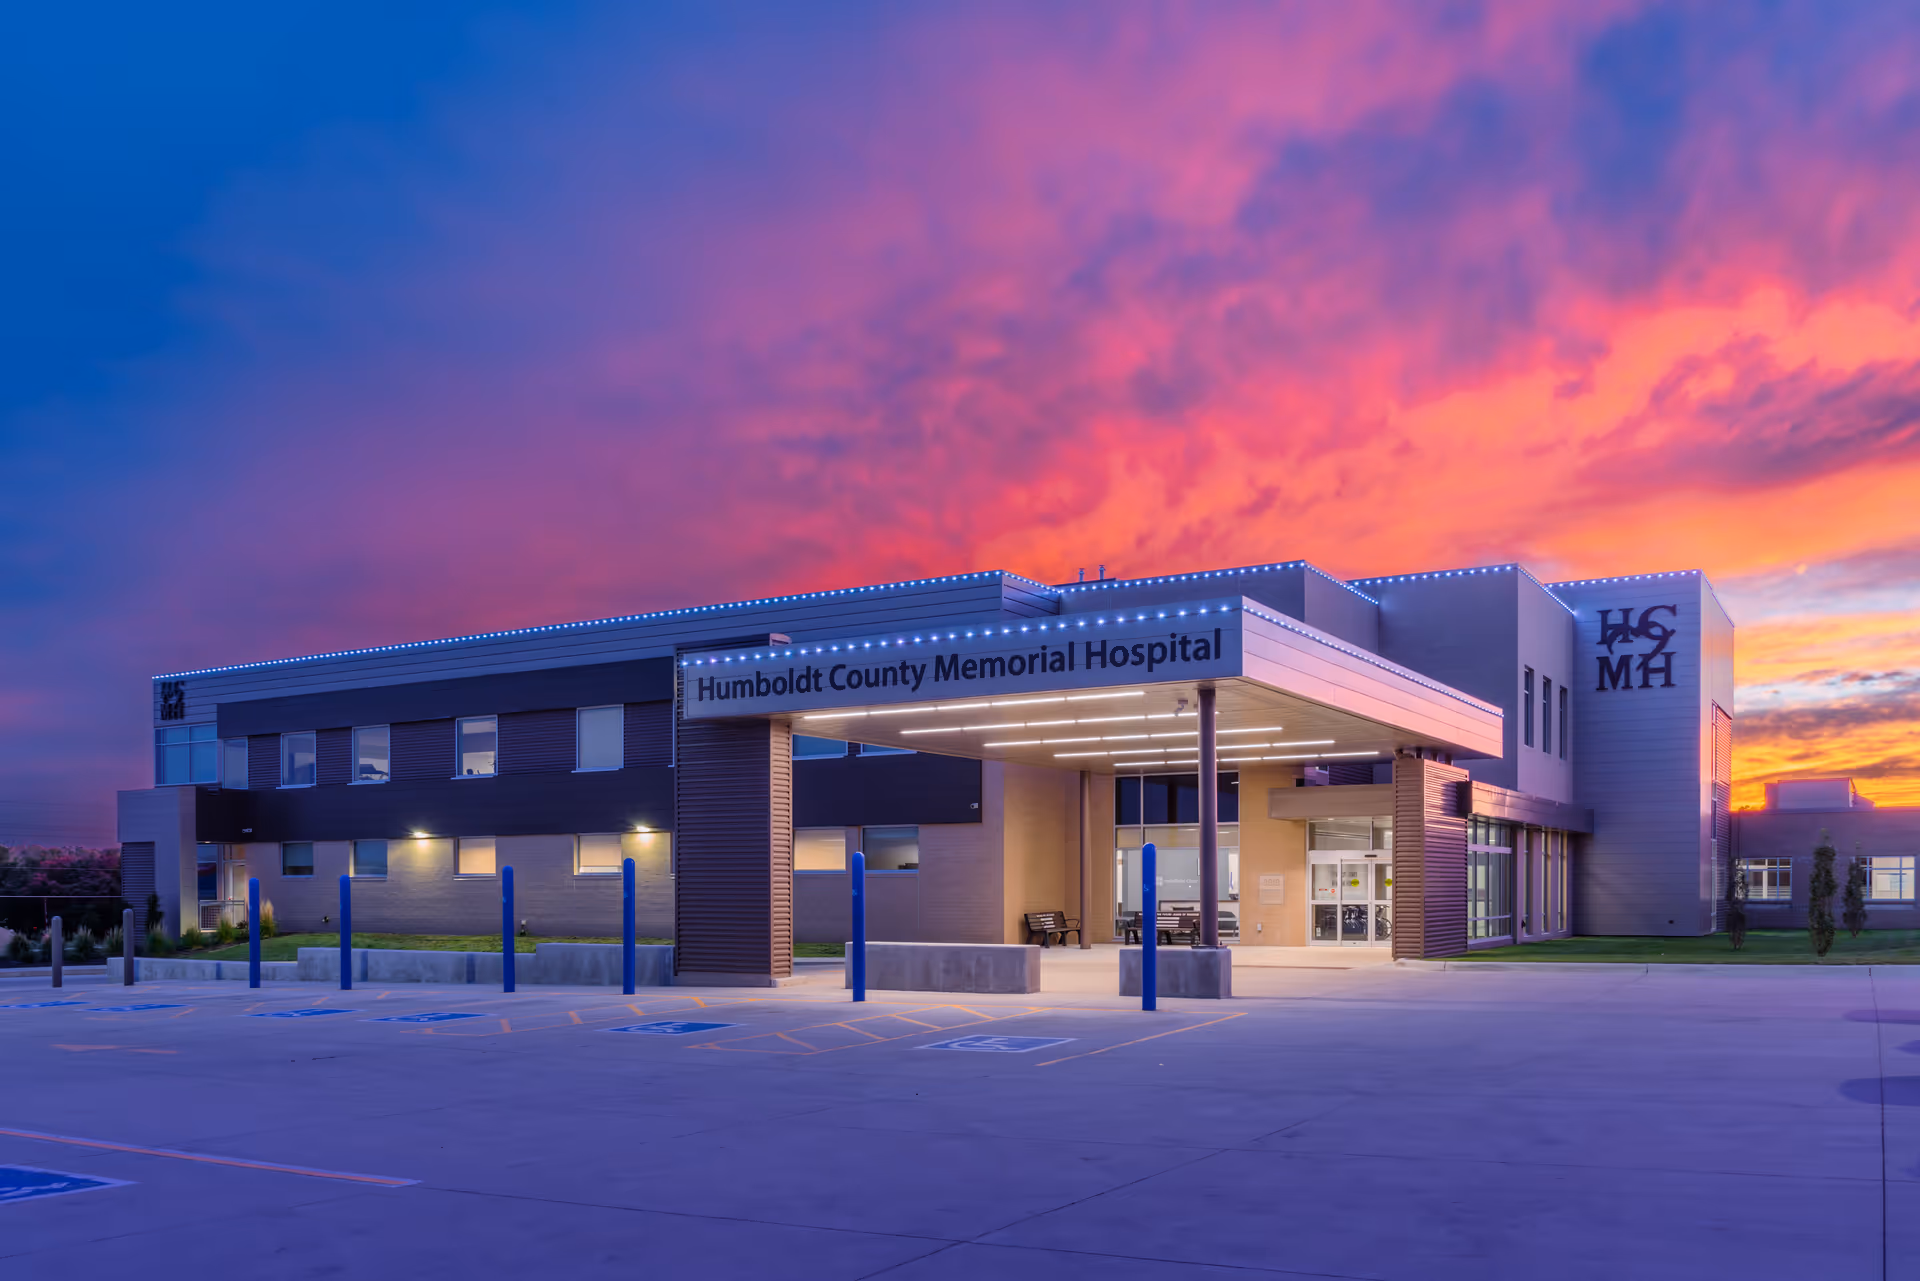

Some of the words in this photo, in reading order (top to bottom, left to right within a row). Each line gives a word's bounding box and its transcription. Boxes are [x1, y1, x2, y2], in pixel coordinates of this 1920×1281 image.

[698, 665, 823, 702] Humboldt
[829, 660, 926, 693] County
[934, 641, 1075, 682] Memorial
[1086, 628, 1221, 672] Hospital
[1595, 651, 1677, 691] MH
